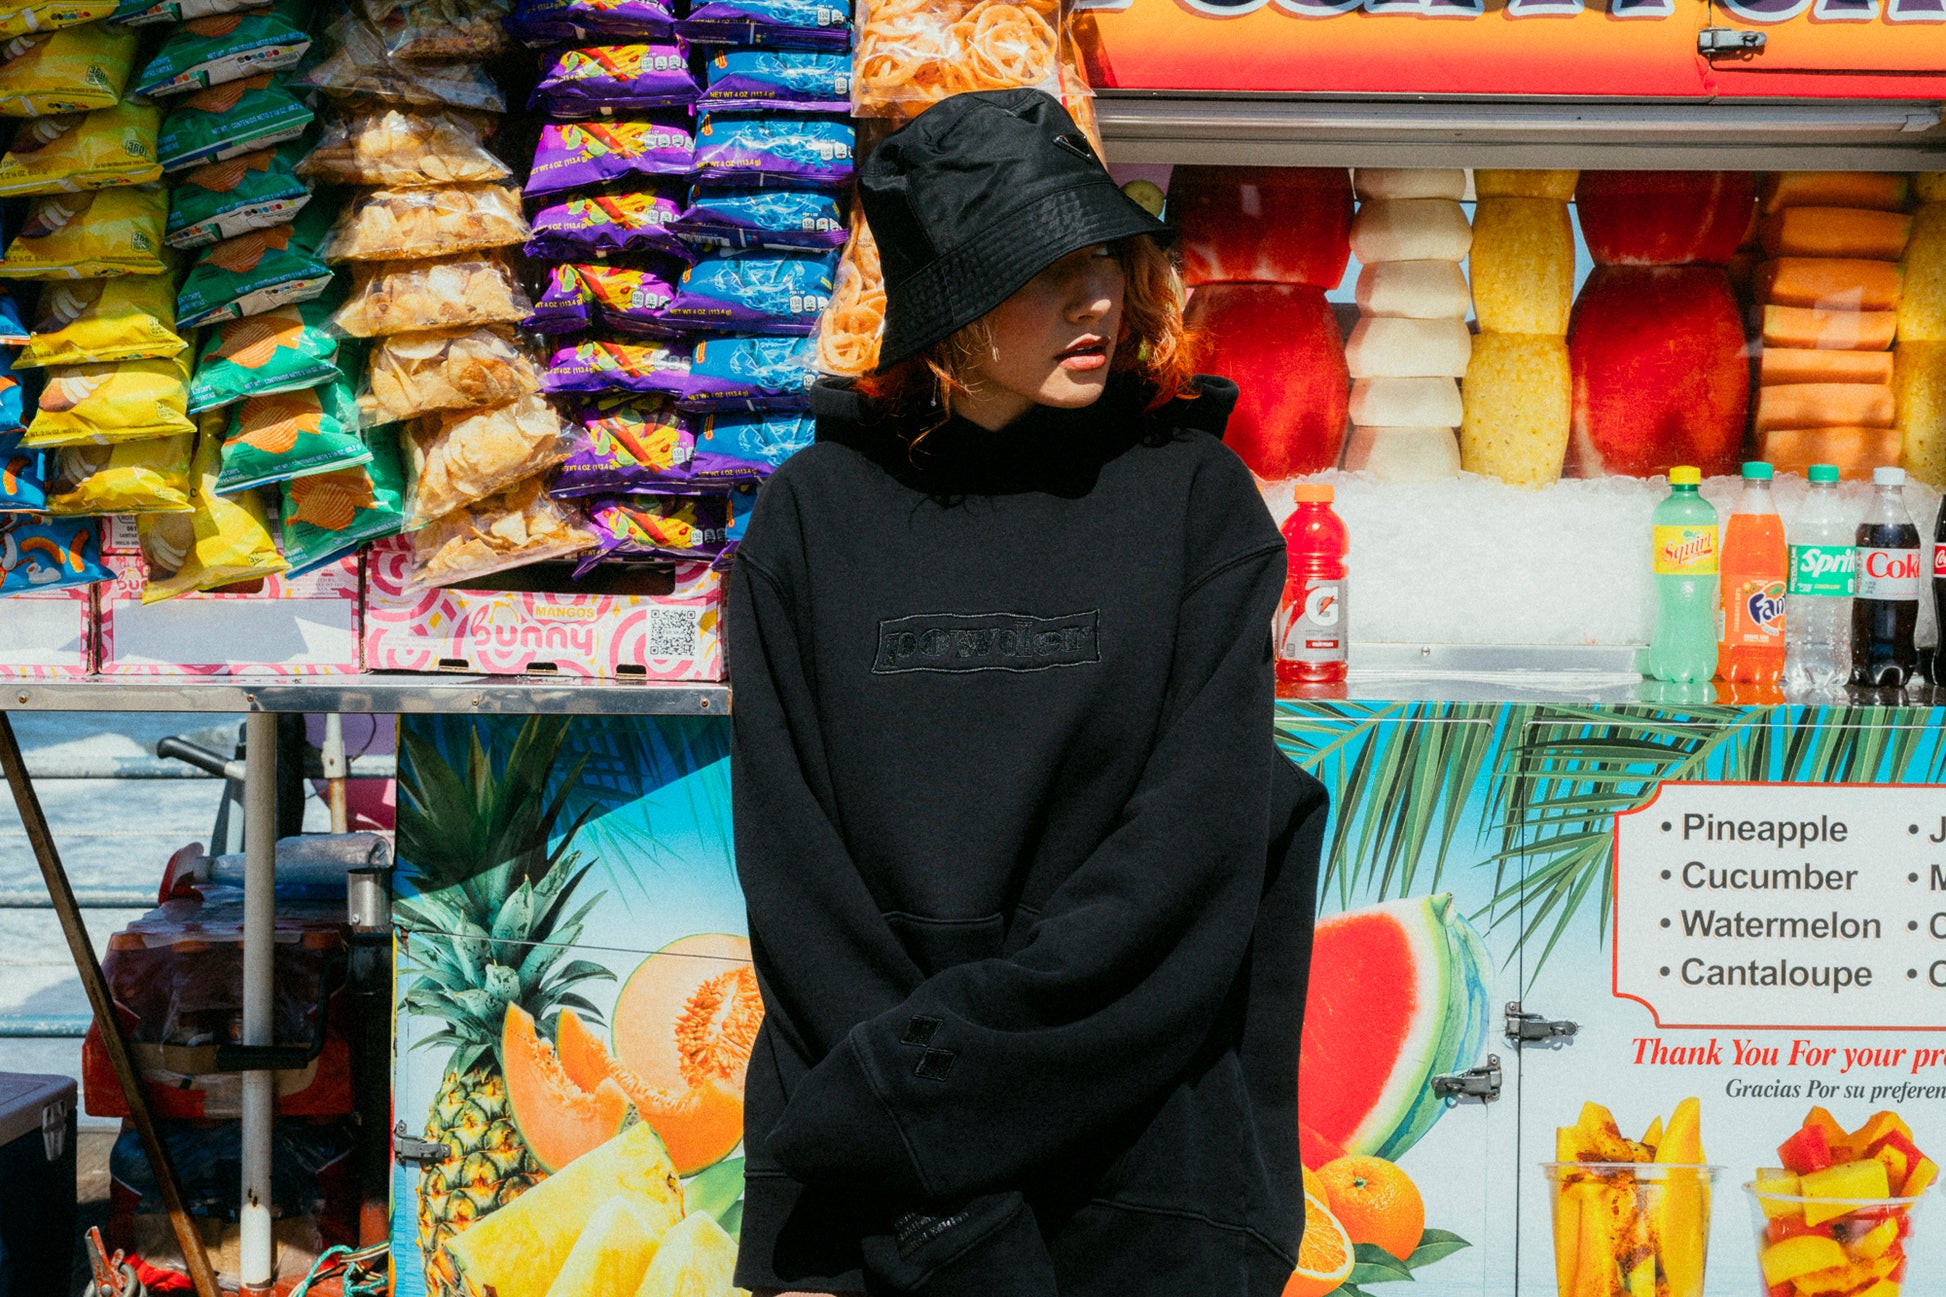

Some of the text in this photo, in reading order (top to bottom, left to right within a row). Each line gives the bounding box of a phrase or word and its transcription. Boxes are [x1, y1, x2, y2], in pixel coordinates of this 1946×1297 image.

[231, 115, 257, 129] CONTENIDO
[257, 112, 269, 121] NETO
[127, 141, 145, 155] 360
[539, 165, 549, 174] WT
[553, 161, 562, 169] OZ
[553, 223, 562, 231] OZ
[560, 300, 577, 308] (113.4
[264, 373, 290, 385] CONTENIDO
[289, 370, 302, 379] NETO
[1664, 532, 1713, 564] Squirt
[536, 606, 595, 619] MANGOS
[1305, 586, 1339, 626] G
[471, 603, 594, 656] bunny
[884, 620, 1093, 667] powder
[1683, 813, 1848, 849] Pineapple
[1682, 861, 1859, 890] Cucumber
[1681, 909, 1881, 939] Watermelon
[1681, 957, 1872, 994] Cantaloupe
[1632, 1038, 1722, 1066] Thank
[1732, 1039, 1779, 1067] You
[1788, 1039, 1836, 1067] For
[1840, 1047, 1907, 1074] your
[1725, 1078, 1800, 1099] Gracias
[1806, 1079, 1840, 1099] Por
[1844, 1085, 1865, 1099] su
